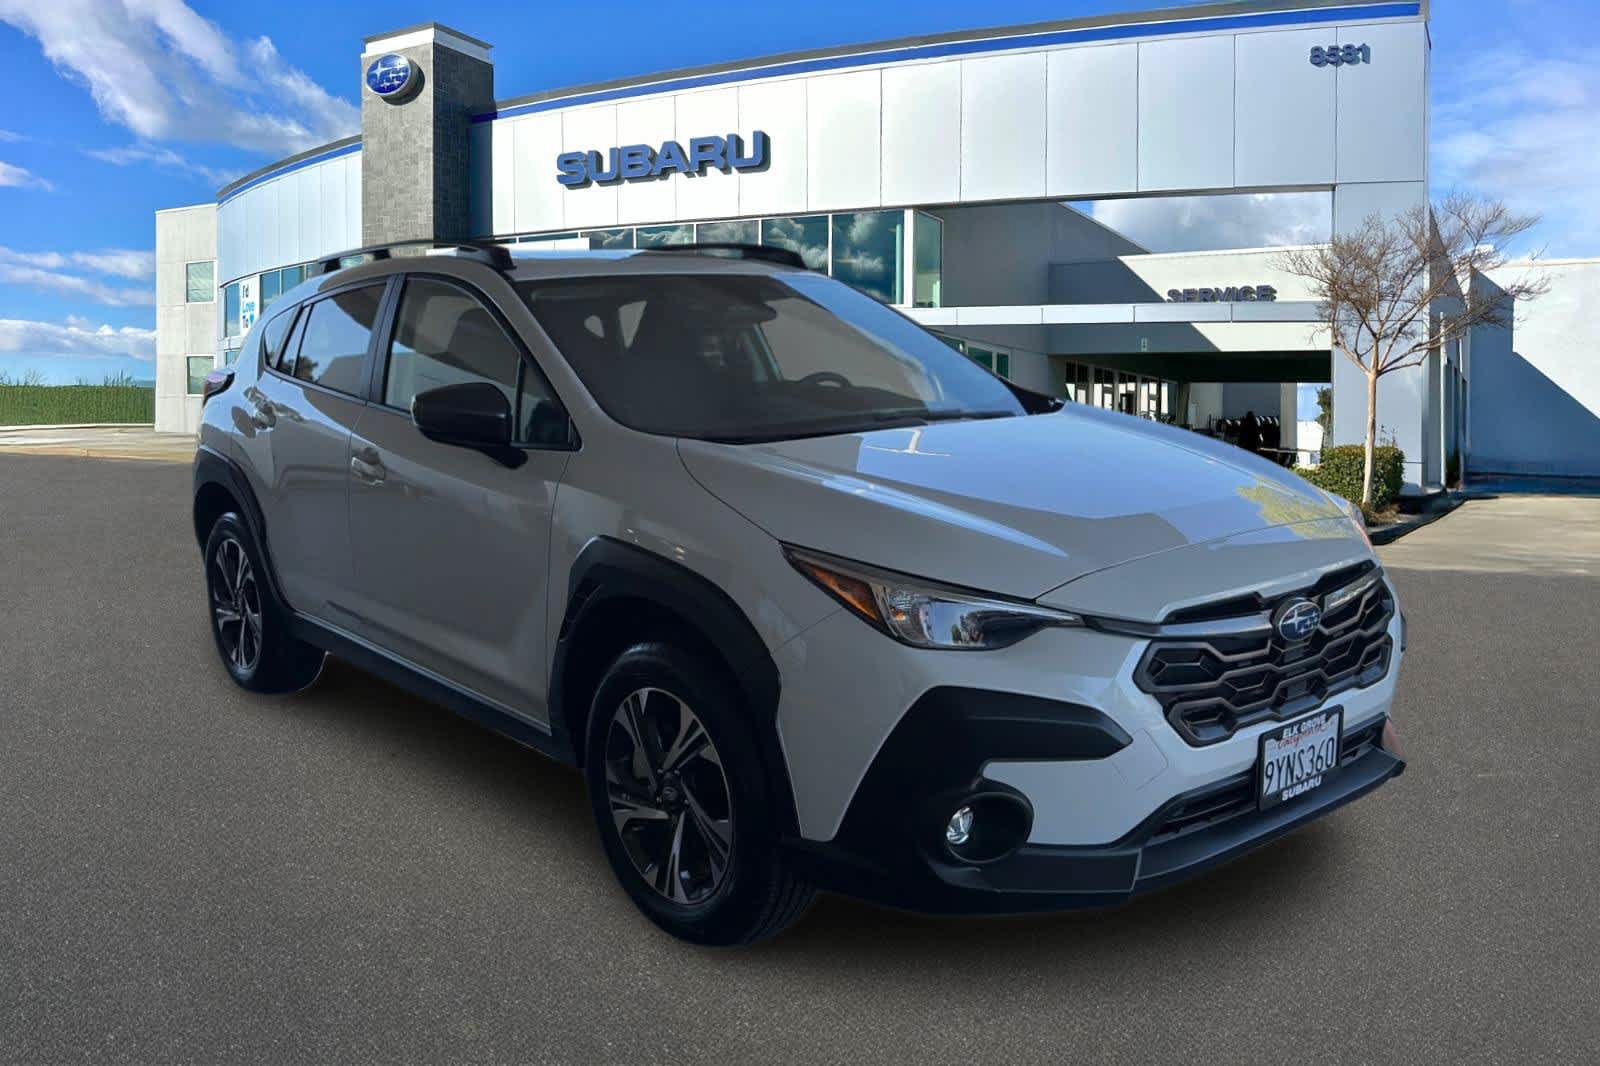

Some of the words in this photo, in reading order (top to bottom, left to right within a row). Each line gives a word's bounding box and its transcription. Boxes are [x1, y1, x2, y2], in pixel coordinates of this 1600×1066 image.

[556, 130, 771, 190] SUBARU
[1166, 285, 1277, 302] SERVICE
[1265, 737, 1335, 796] 9YNS360
[1281, 775, 1322, 801] SUBARU
